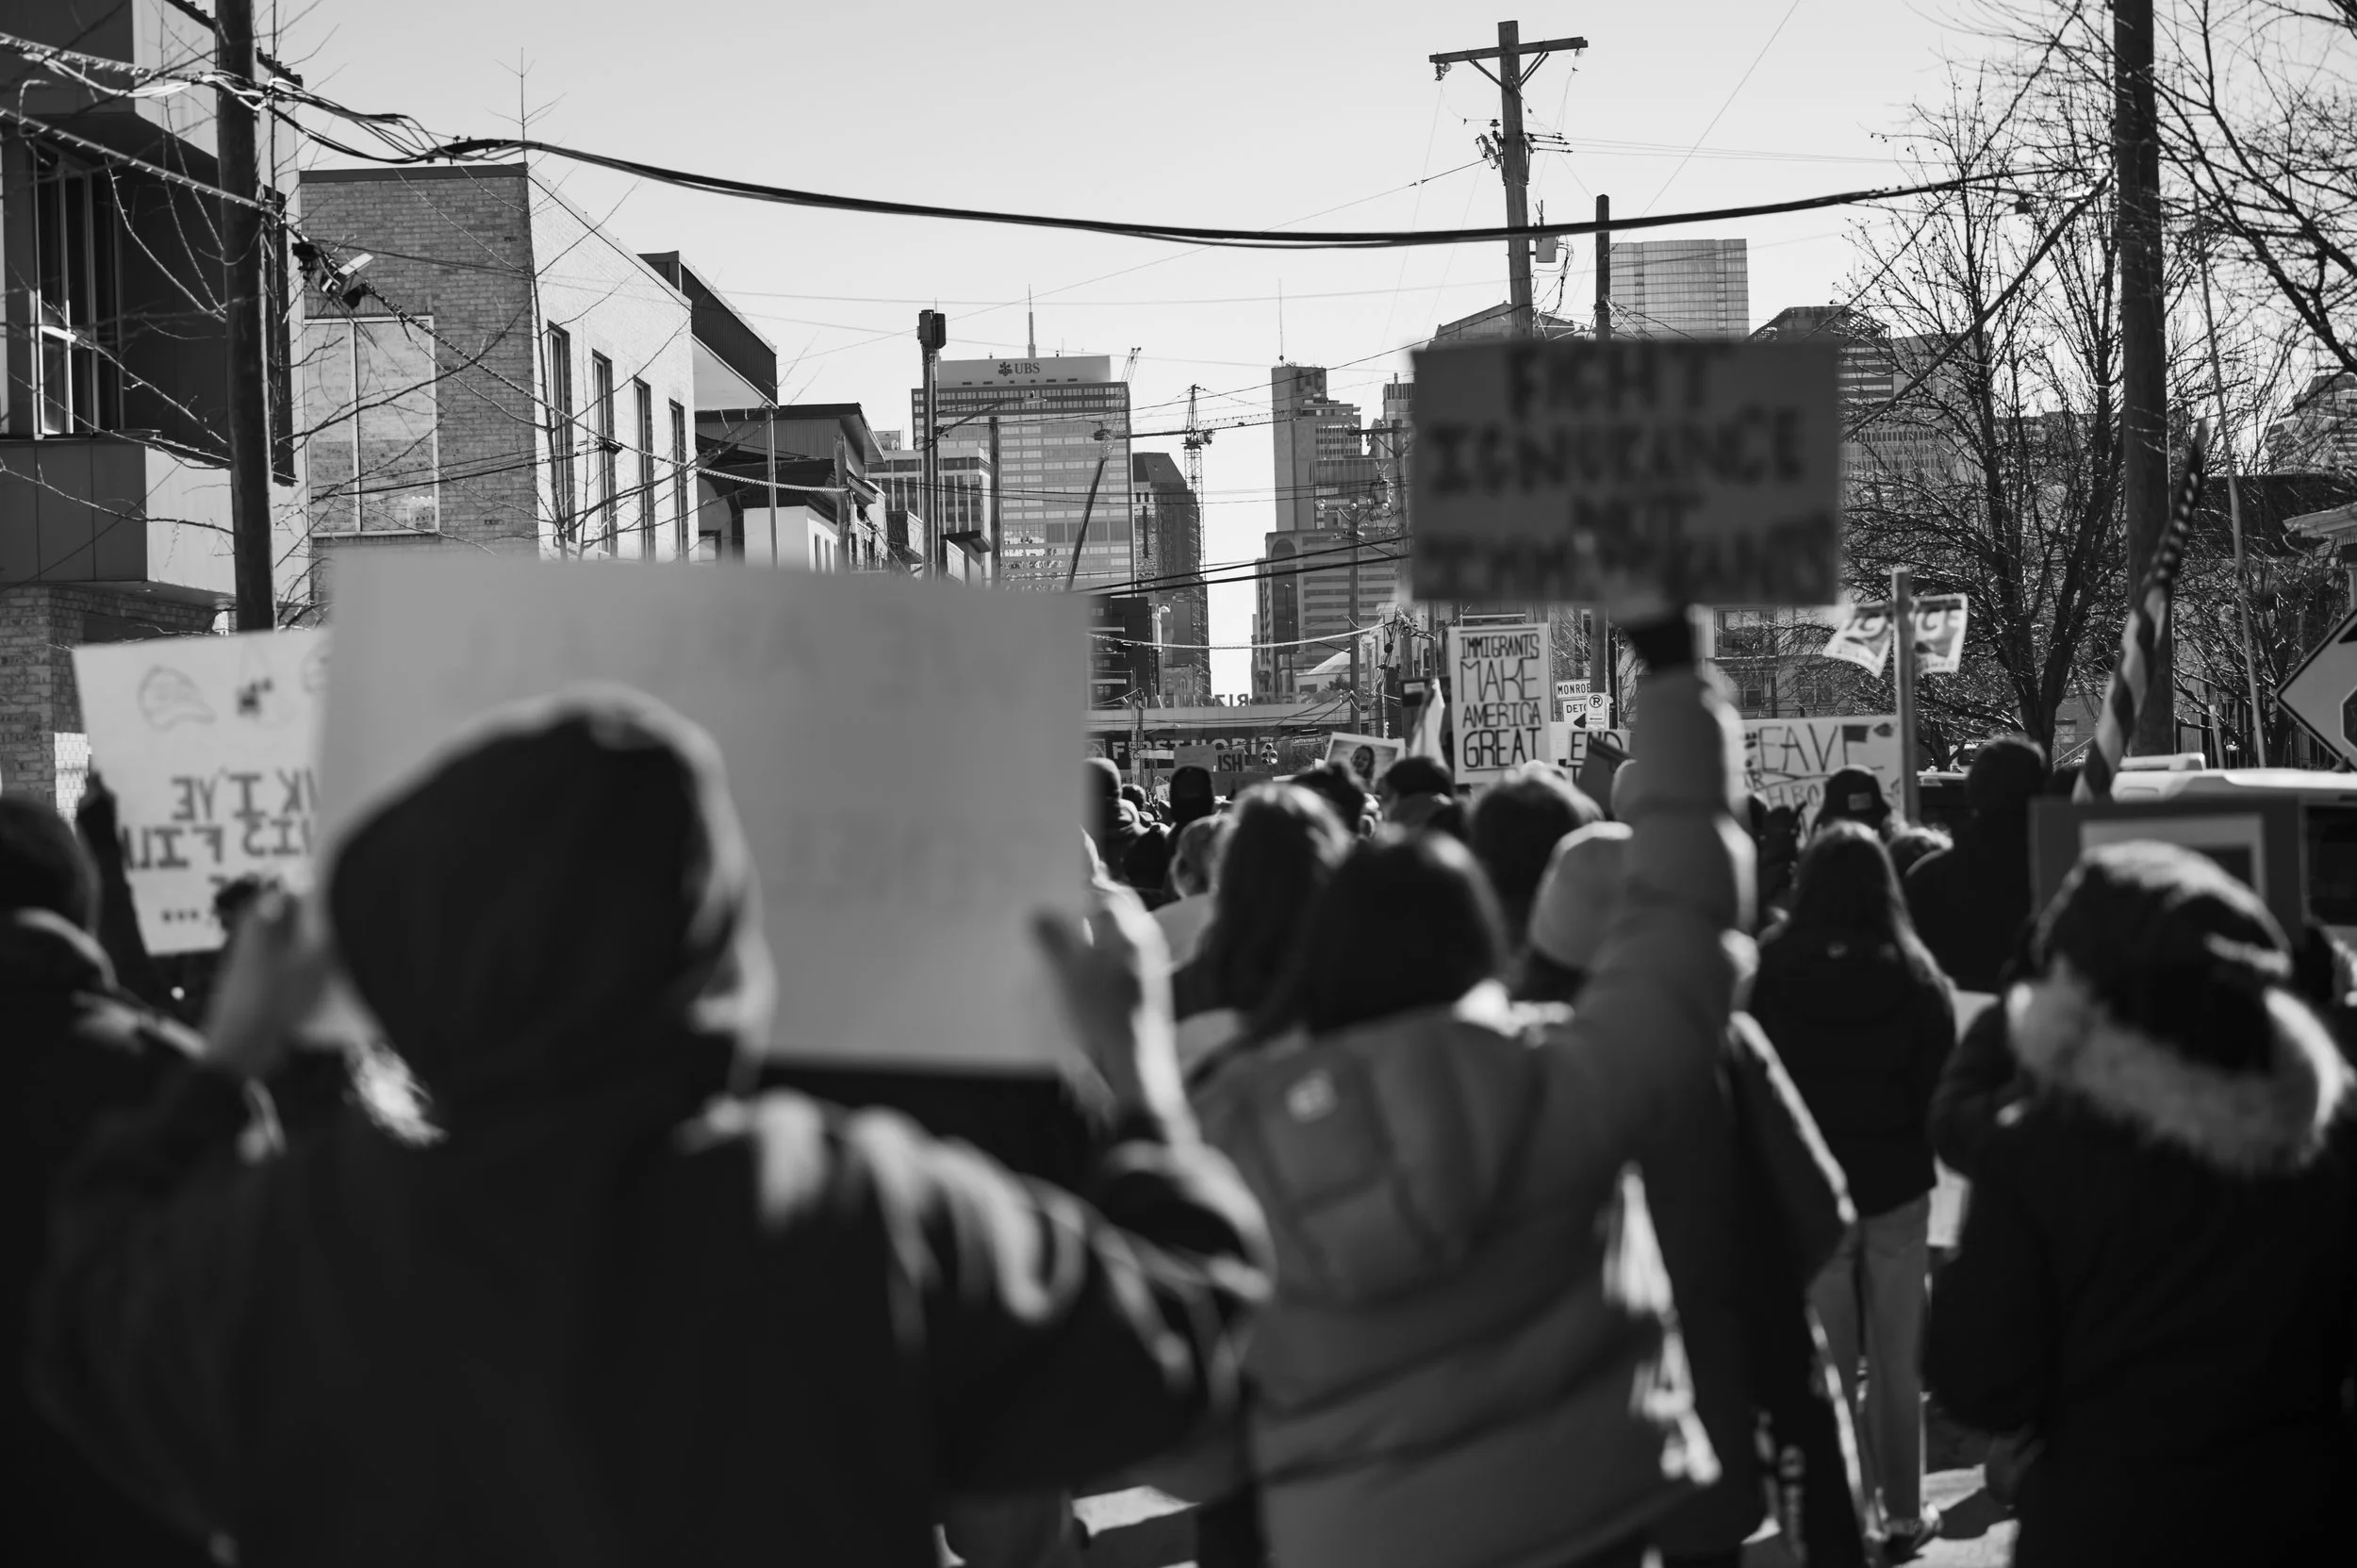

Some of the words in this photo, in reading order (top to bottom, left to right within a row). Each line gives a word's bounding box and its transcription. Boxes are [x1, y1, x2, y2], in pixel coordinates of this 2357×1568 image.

[1014, 362, 1040, 374] UBS
[1459, 633, 1540, 659] IMMIGRANTS
[1460, 657, 1541, 701] MAKE
[1463, 701, 1541, 728] AMERICA
[1463, 727, 1541, 767] GREAT
